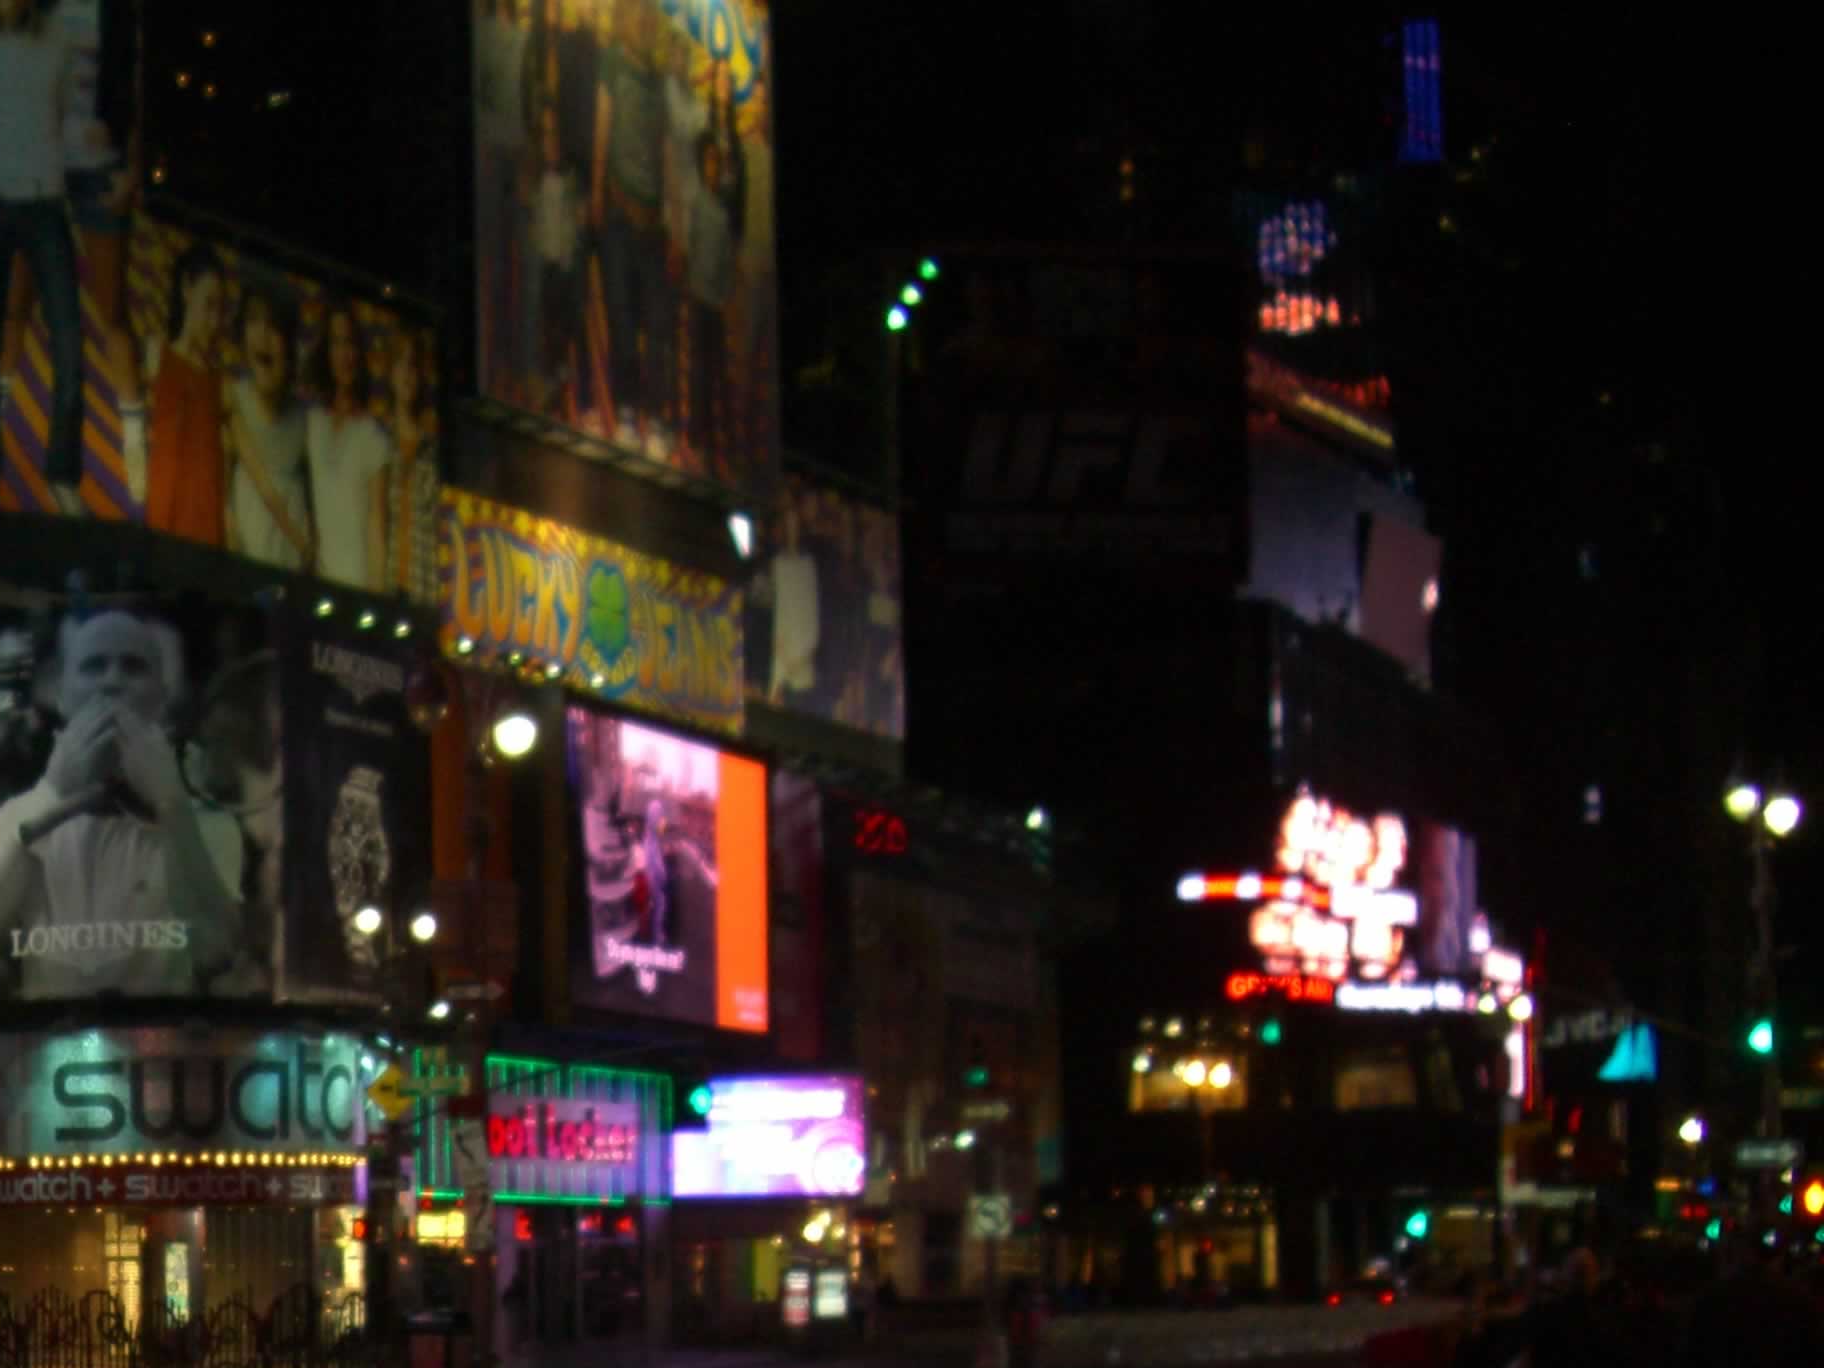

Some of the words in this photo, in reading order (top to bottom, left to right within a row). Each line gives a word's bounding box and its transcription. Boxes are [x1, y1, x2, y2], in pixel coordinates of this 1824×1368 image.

[10, 919, 189, 957] LONGINES
[487, 1104, 539, 1157] oot
[125, 1170, 265, 1200] swatch
